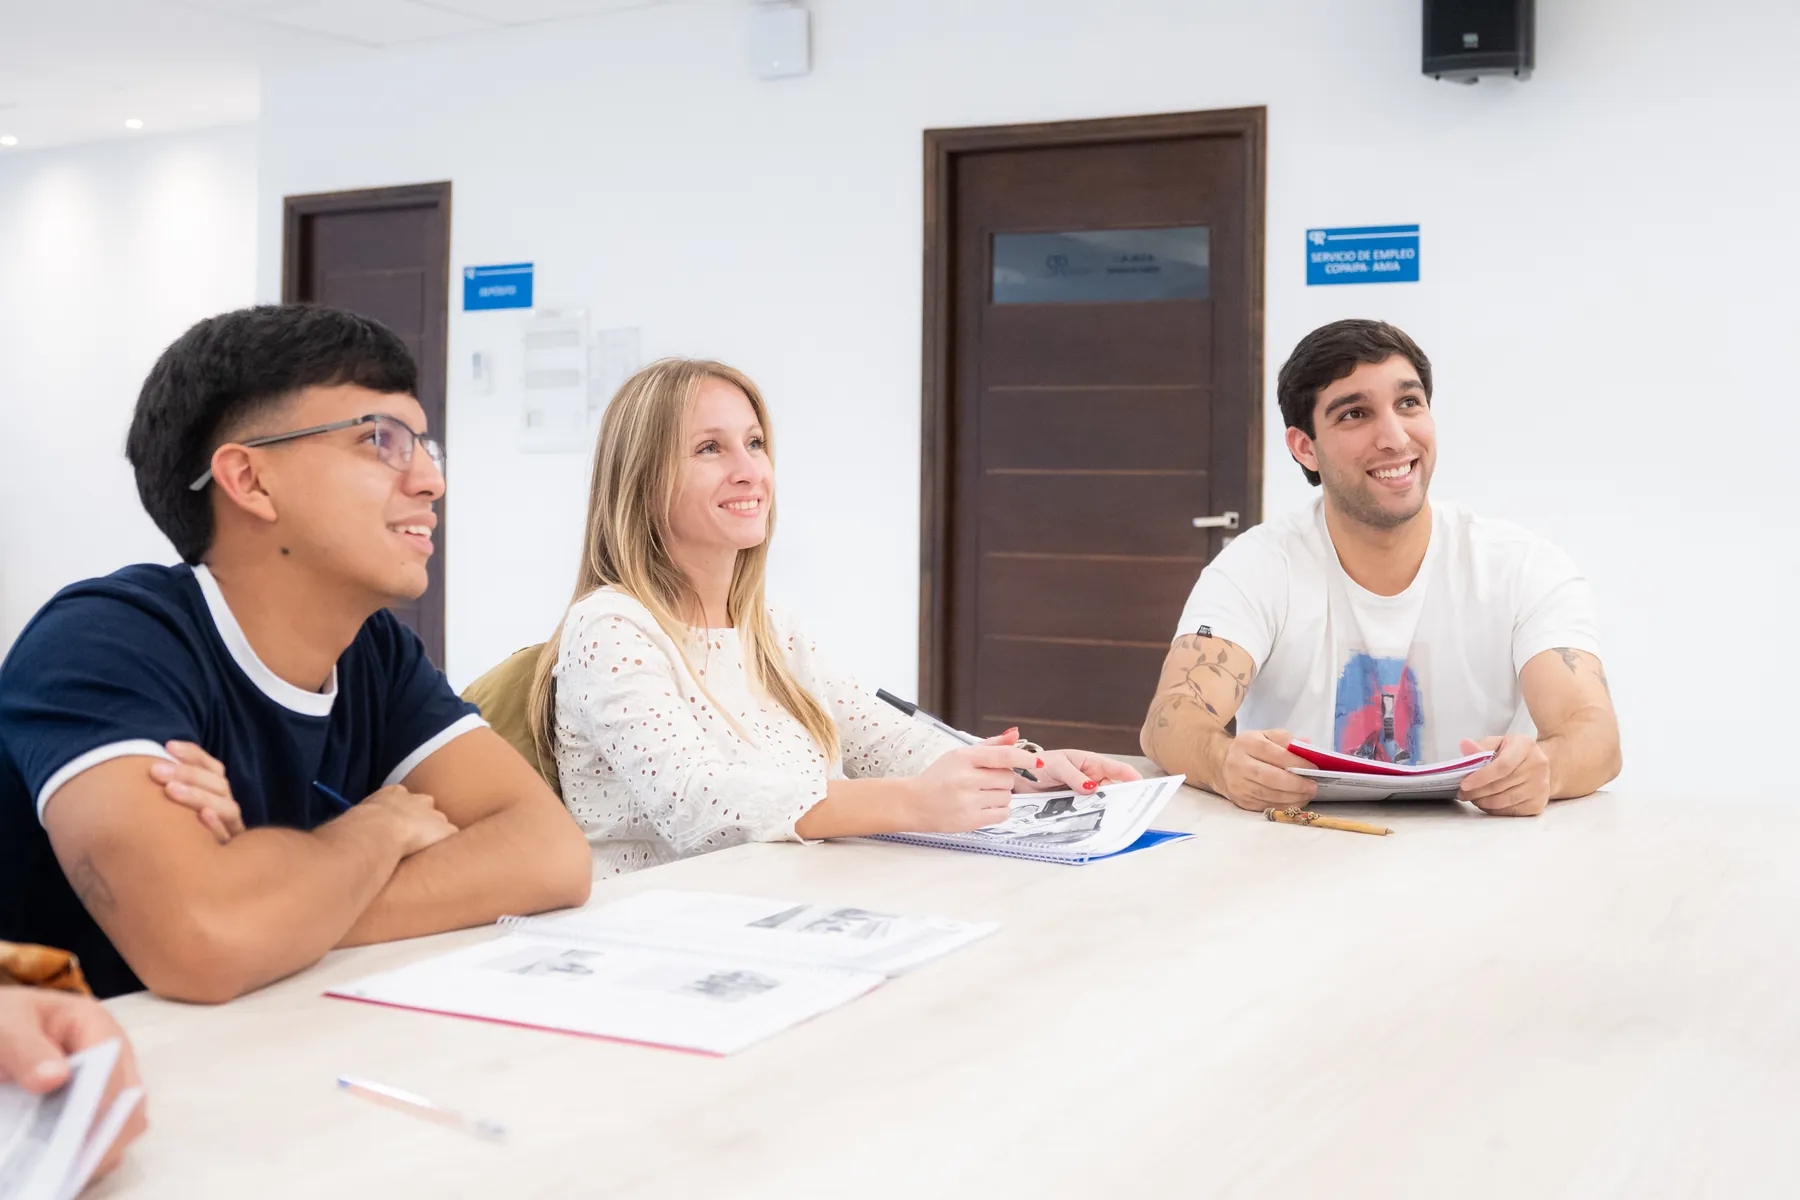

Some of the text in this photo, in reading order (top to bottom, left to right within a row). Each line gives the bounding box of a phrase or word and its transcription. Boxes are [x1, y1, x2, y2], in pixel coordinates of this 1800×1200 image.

[1311, 248, 1415, 262] SERVICIO DE EMPLEO
